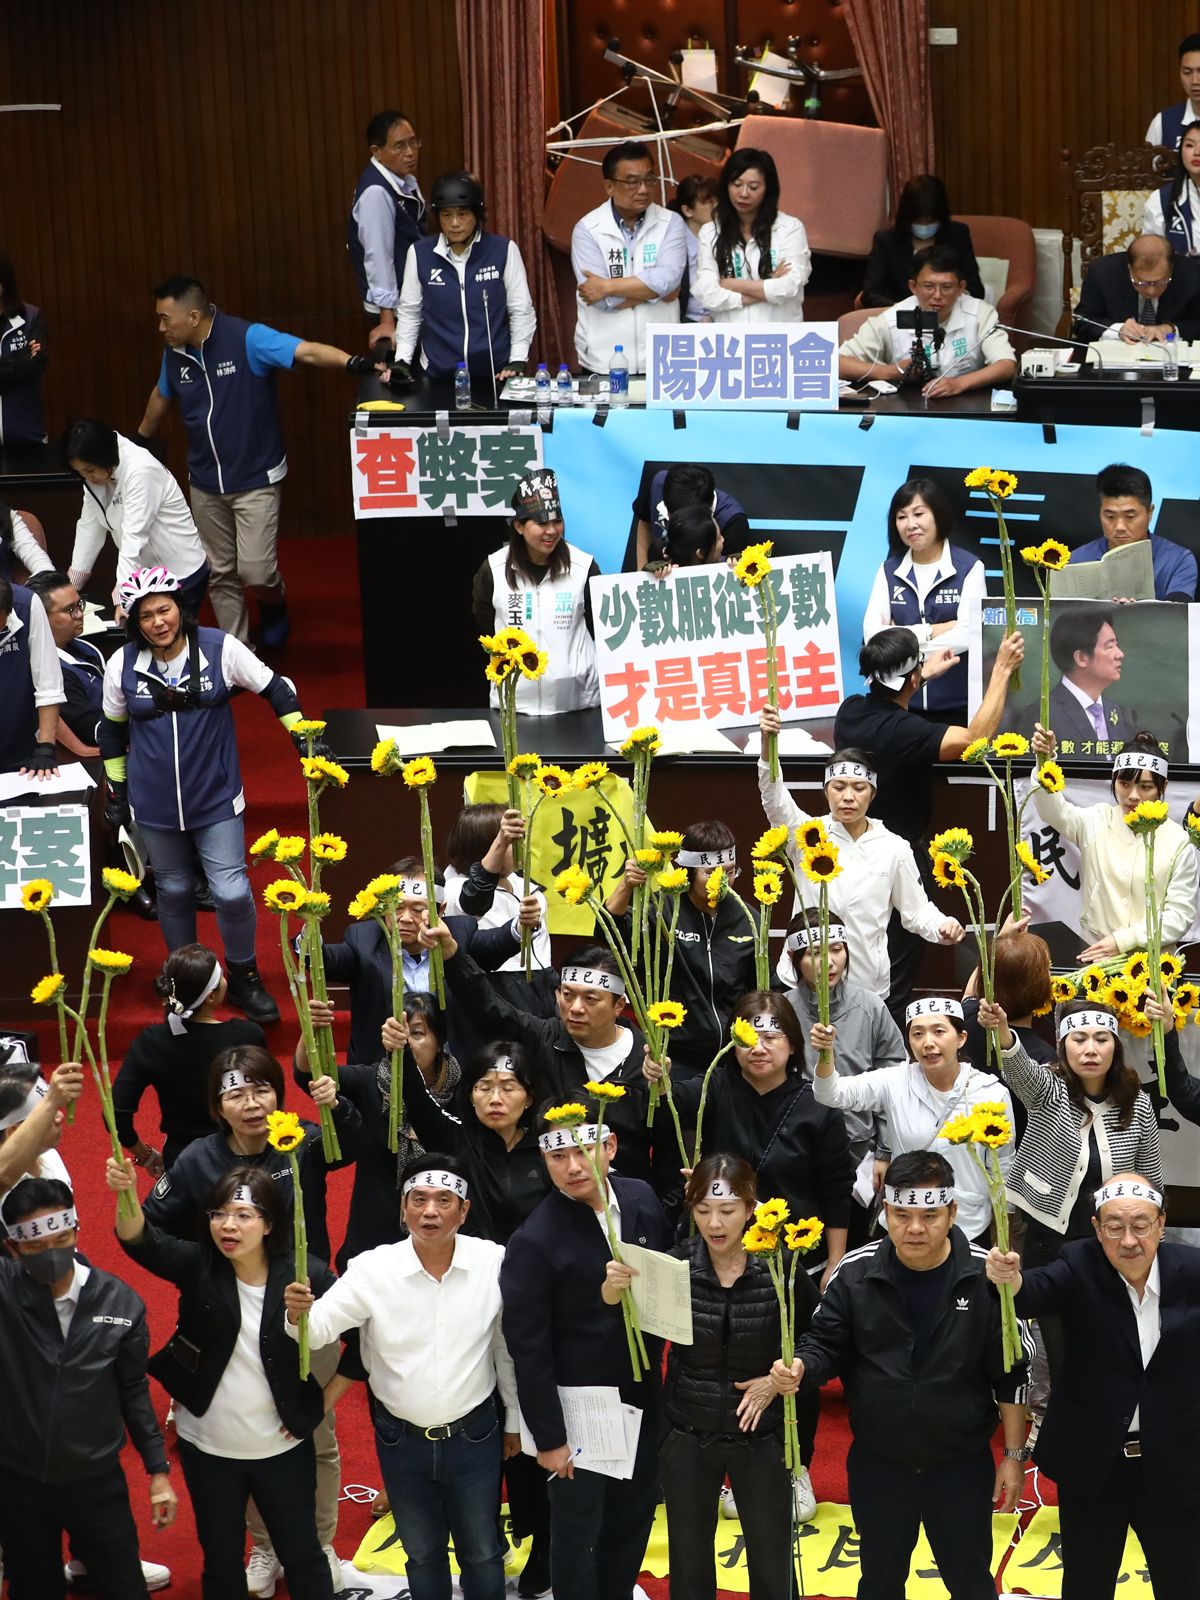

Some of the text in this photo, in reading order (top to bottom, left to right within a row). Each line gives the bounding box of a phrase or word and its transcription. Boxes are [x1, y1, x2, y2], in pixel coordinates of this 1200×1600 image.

[653, 332, 834, 401] 陽光國會
[356, 432, 538, 511] 查弊案
[599, 563, 831, 652] 少數服從多數
[604, 640, 840, 729] 才是真民主
[829, 764, 872, 780] 民主已死
[562, 968, 611, 988] 民主已死
[1067, 1013, 1115, 1031] 民主已死
[892, 1189, 948, 1206] 民主已死
[1101, 1183, 1157, 1202] 民主已死
[15, 1213, 71, 1240] 民主已死
